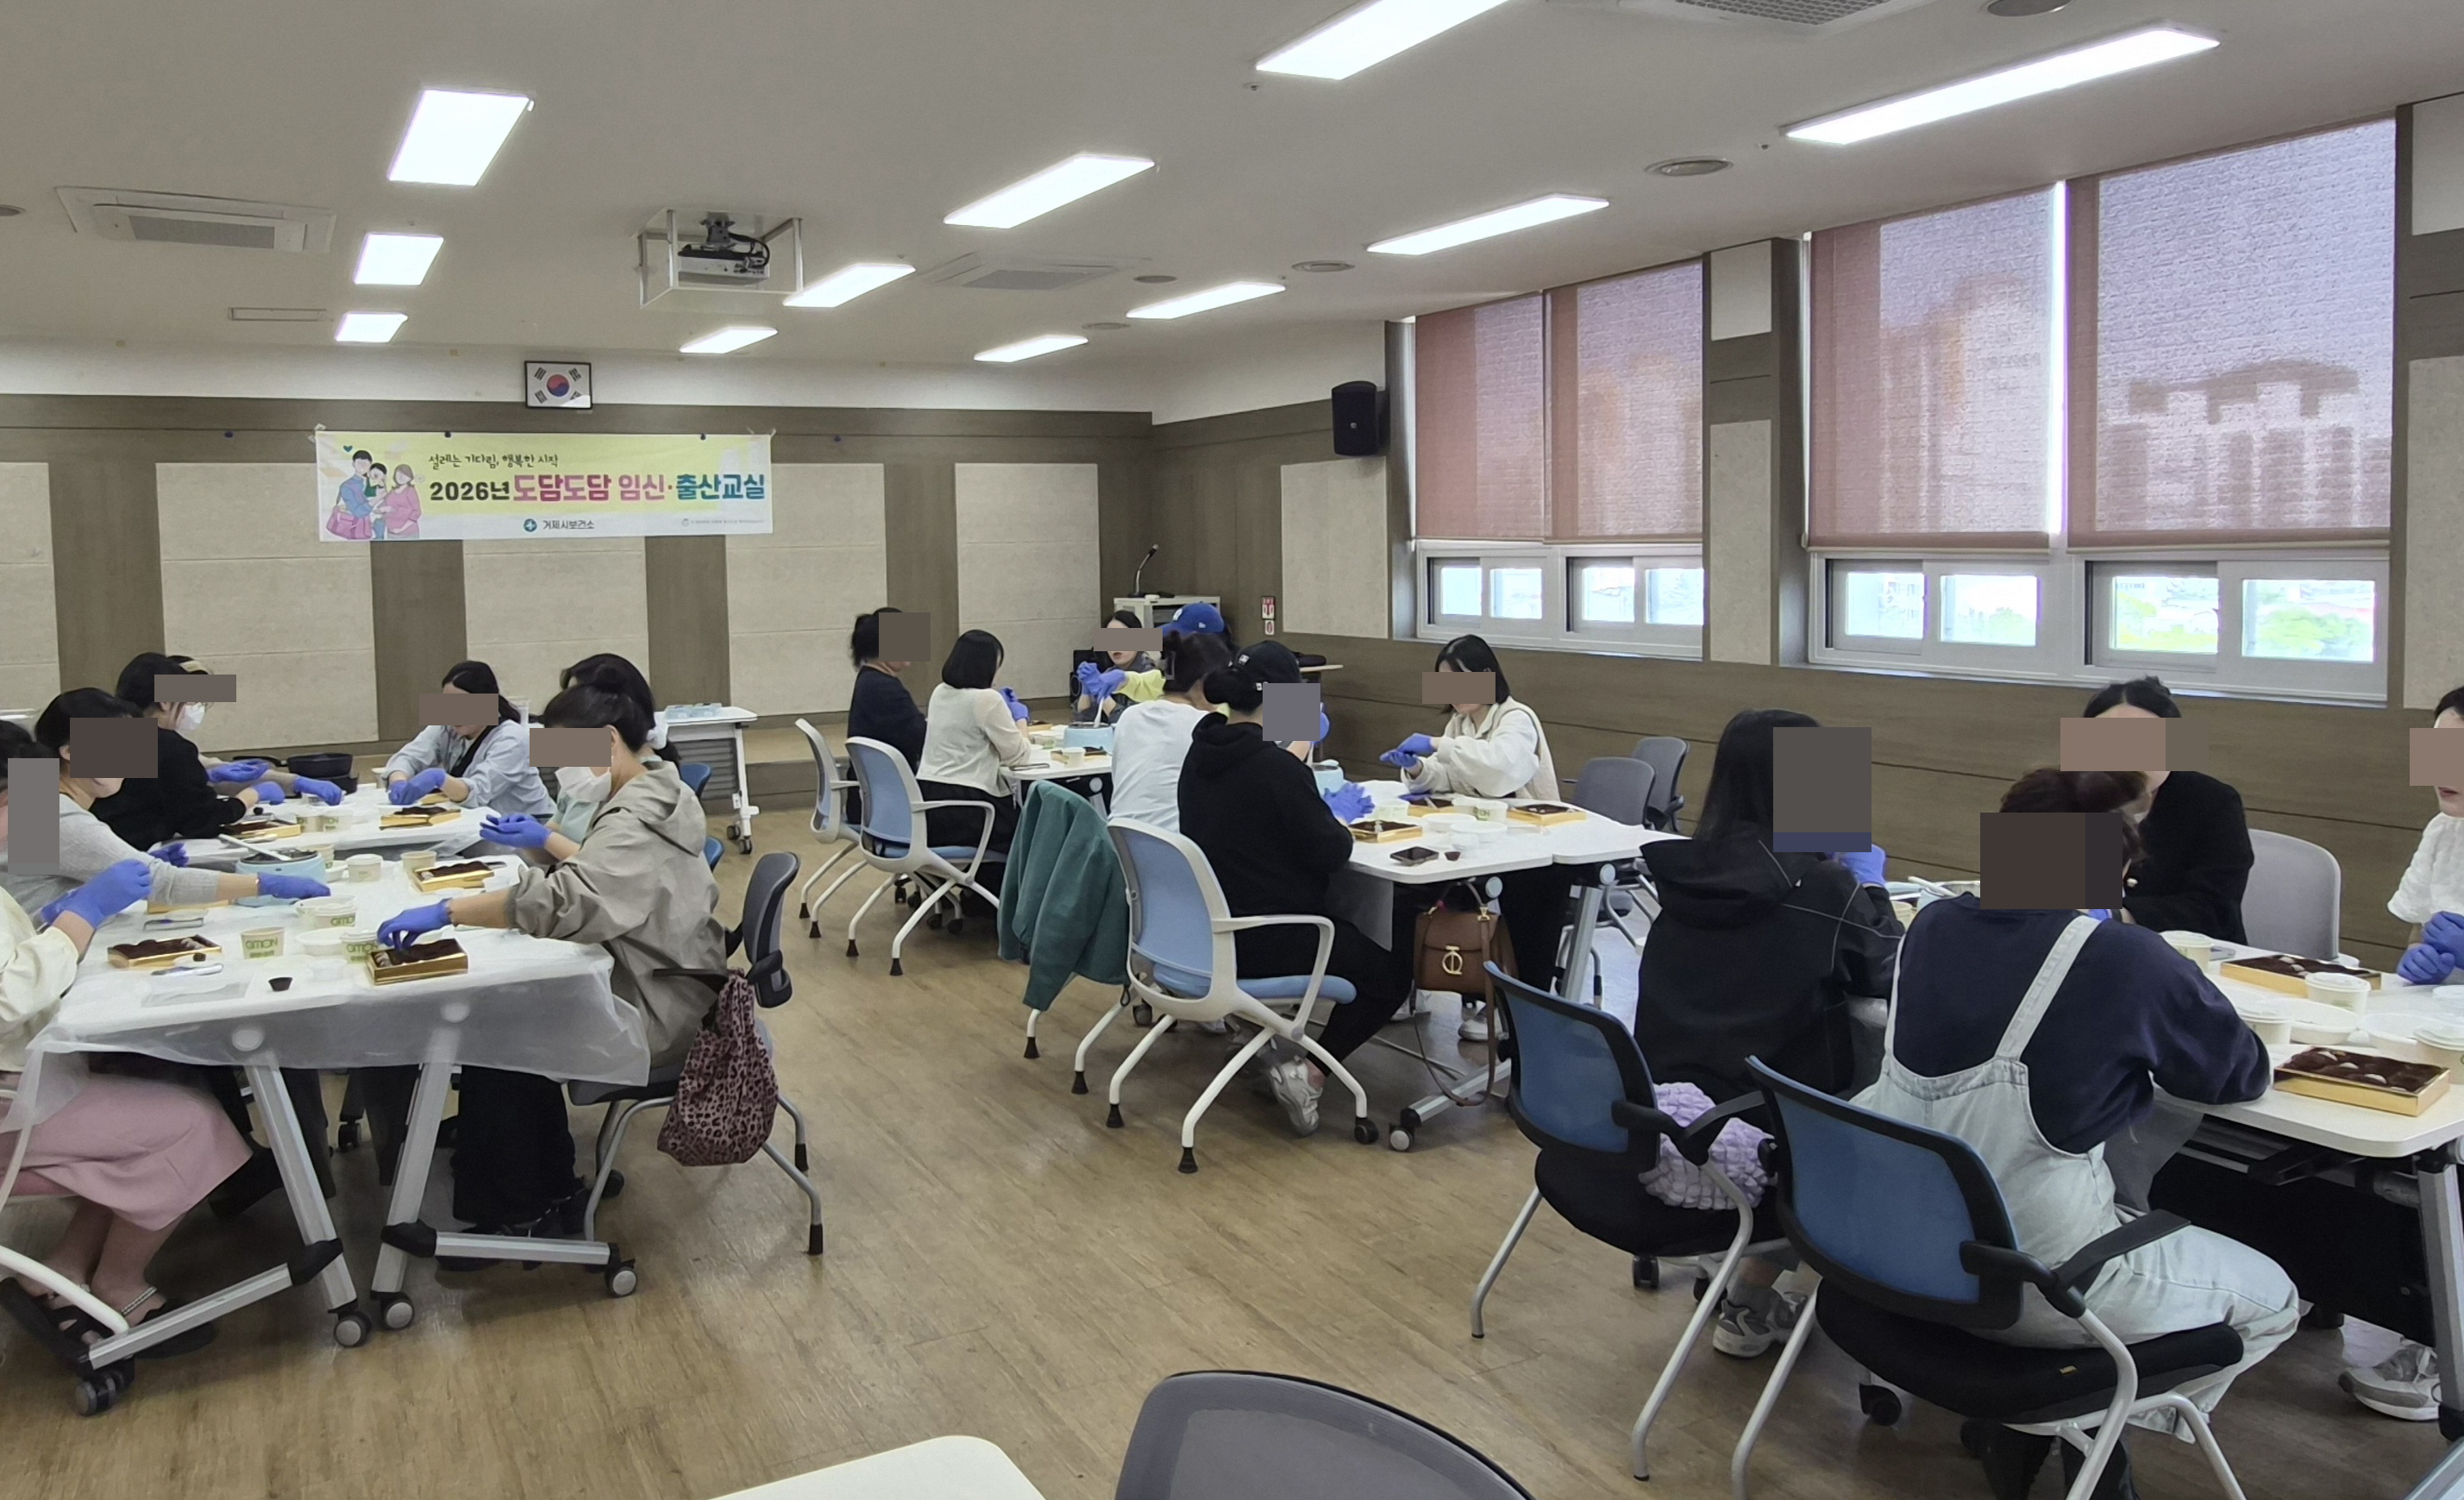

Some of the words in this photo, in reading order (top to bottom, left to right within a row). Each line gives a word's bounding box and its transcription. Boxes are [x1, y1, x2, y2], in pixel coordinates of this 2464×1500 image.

[428, 453, 462, 470] 설레는
[501, 454, 535, 468] 행복한
[537, 454, 559, 468] 시작
[429, 480, 511, 501] 2026년
[512, 474, 612, 502] 도담도담
[542, 519, 595, 530] 거제시보건소
